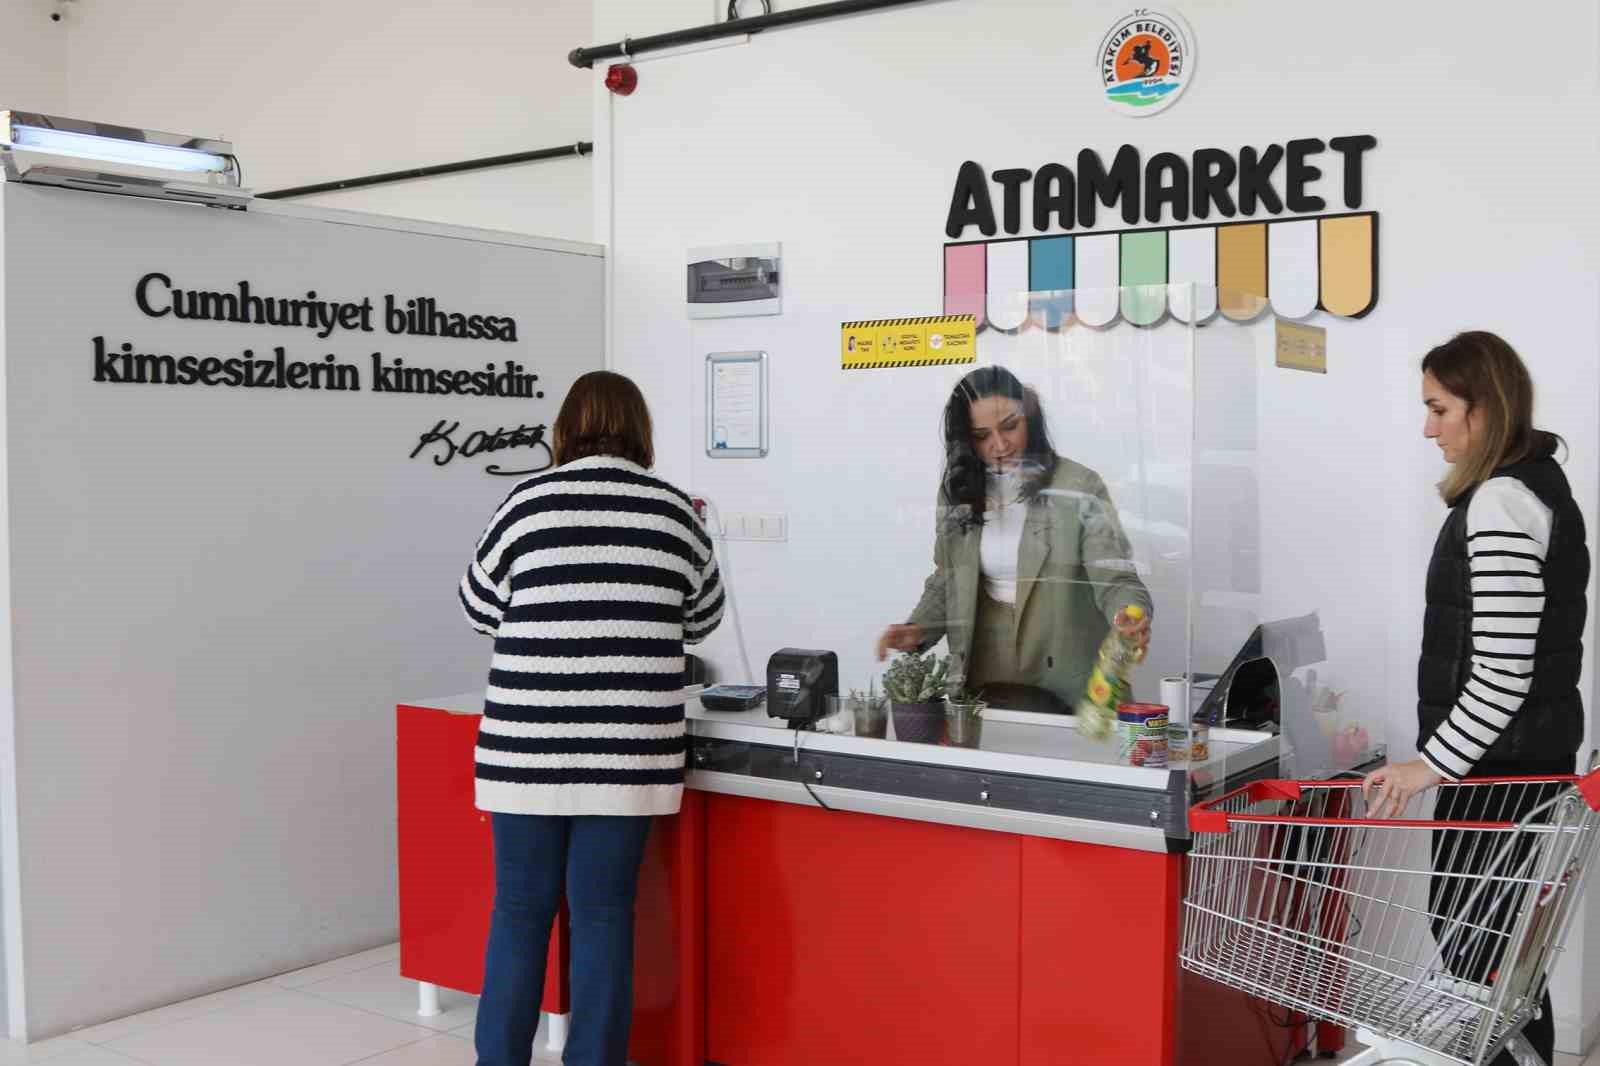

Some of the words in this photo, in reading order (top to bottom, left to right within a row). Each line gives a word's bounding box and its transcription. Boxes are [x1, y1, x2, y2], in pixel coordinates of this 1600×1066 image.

[1104, 29, 1132, 83] ATAKUM
[135, 273, 374, 339] Cumhuriyet
[384, 294, 518, 343] bilhassa
[92, 335, 361, 392] kimsesizlerin
[371, 351, 545, 399] kimsesidir.
